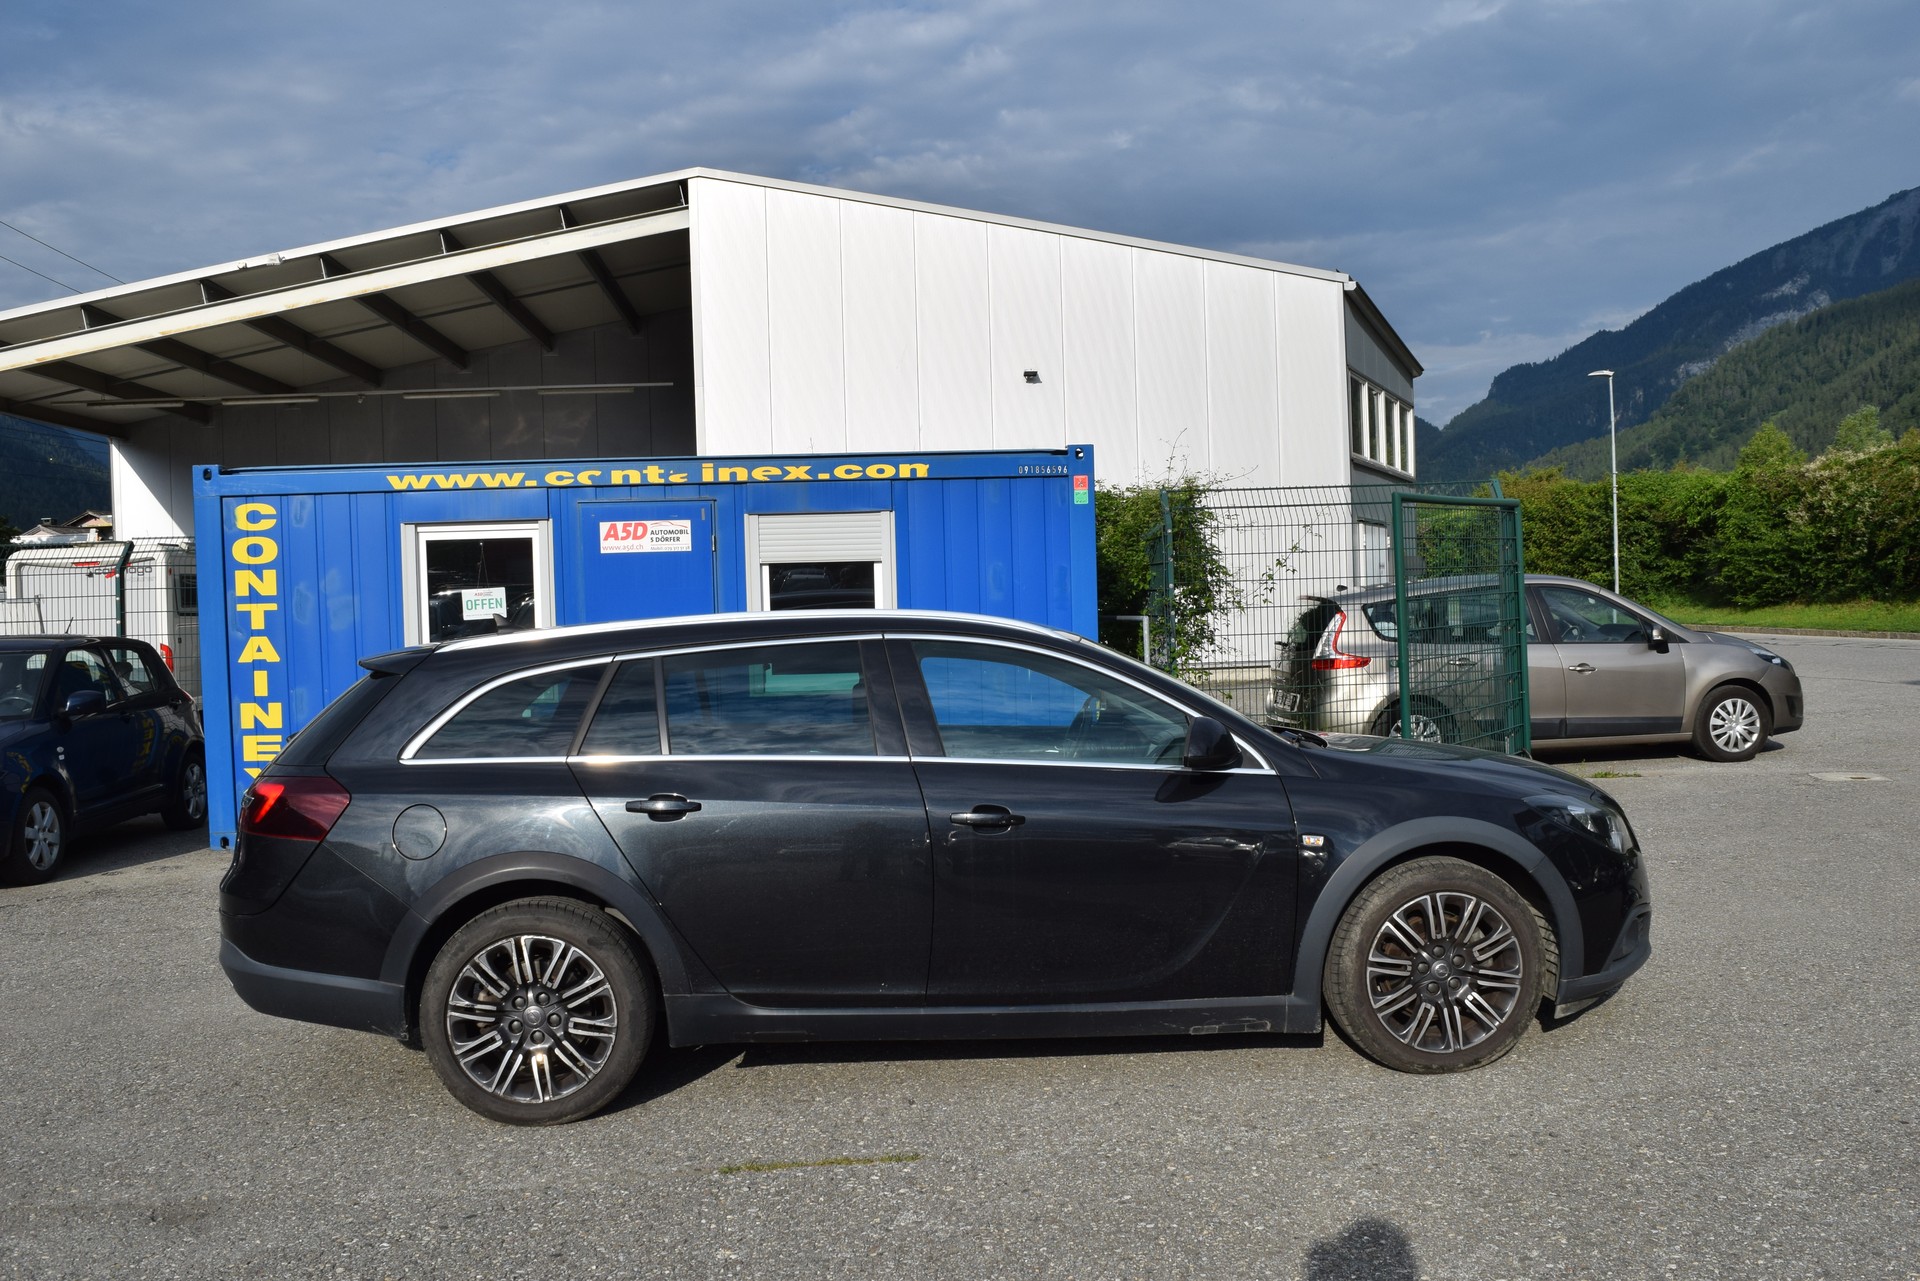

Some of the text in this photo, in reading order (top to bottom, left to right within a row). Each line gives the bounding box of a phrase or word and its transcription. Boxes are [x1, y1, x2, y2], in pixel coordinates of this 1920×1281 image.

[603, 522, 648, 541] A5D
[466, 598, 503, 610] OFFEN
[231, 503, 283, 778] CONTAINE
